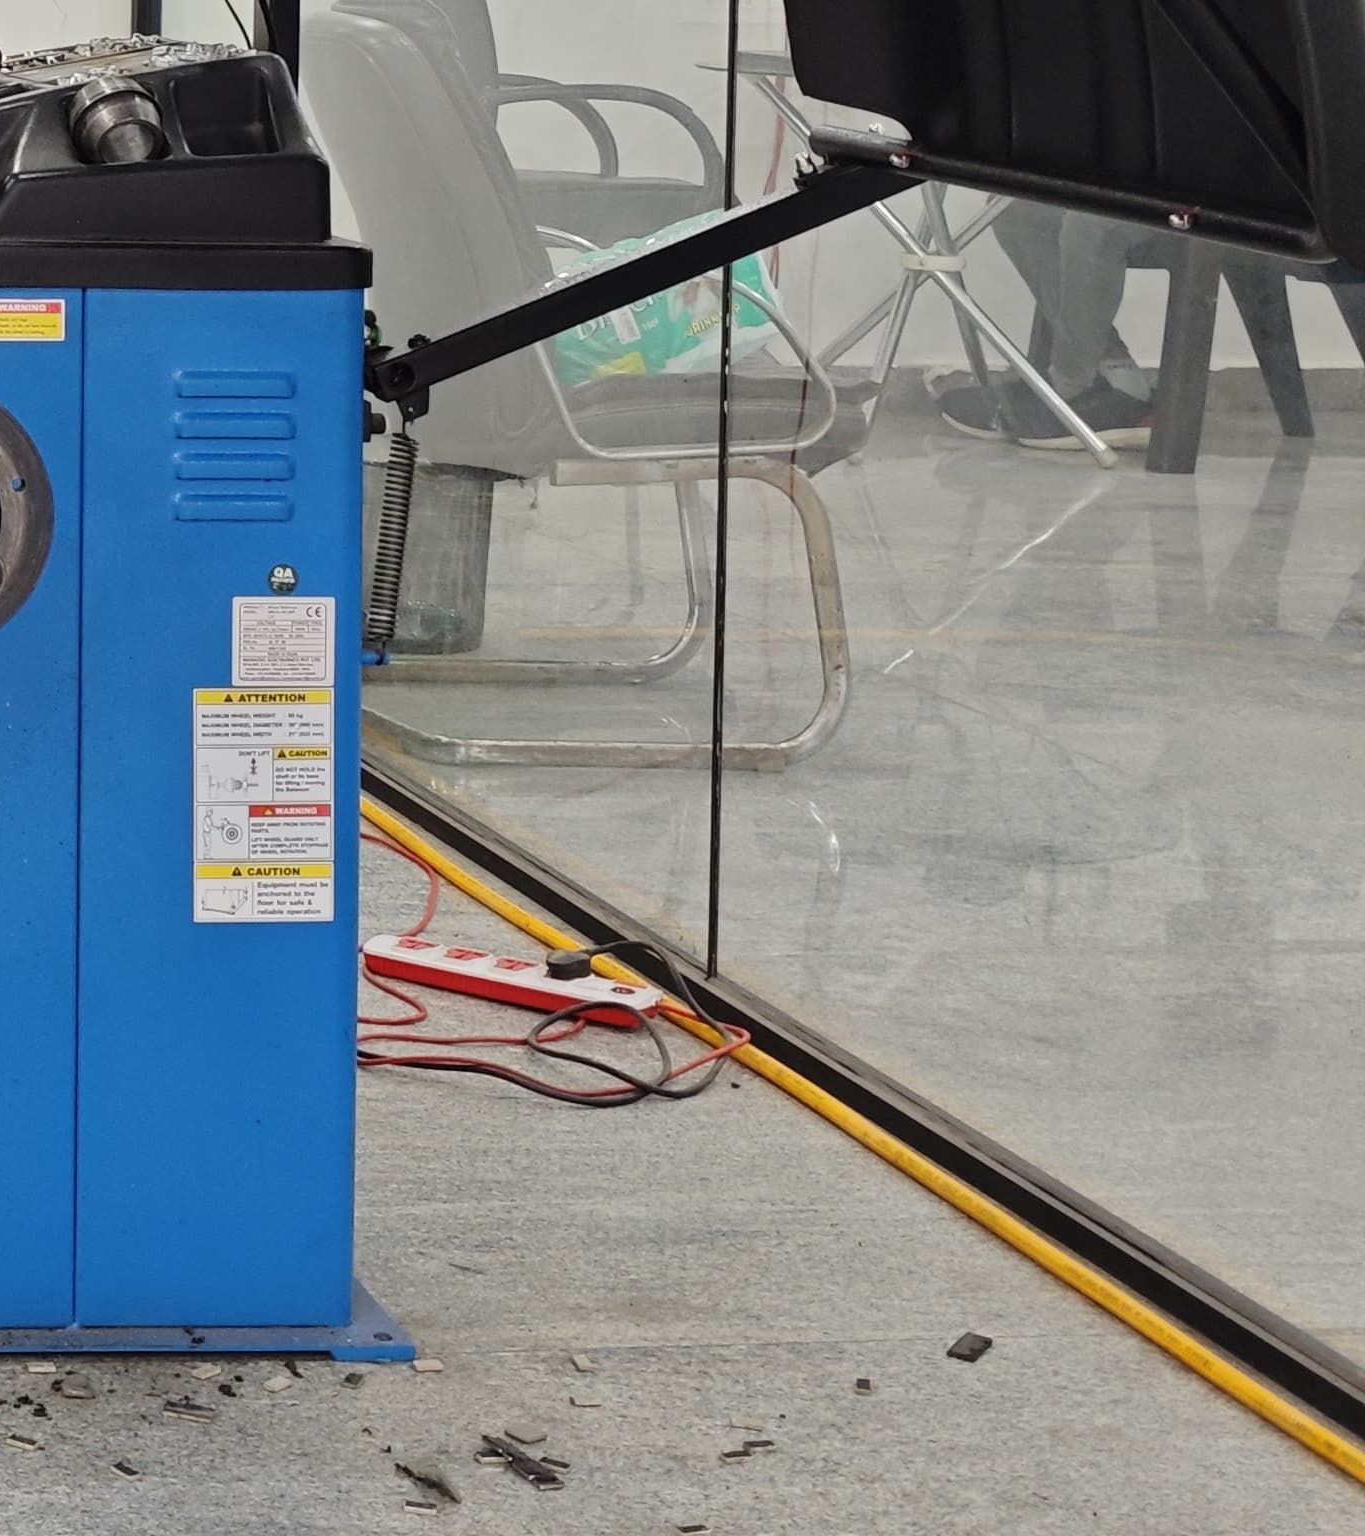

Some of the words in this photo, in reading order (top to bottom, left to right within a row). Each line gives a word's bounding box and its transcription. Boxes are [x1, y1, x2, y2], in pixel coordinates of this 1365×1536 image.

[273, 567, 293, 577] QA
[238, 693, 306, 703] ATTENTION
[247, 867, 300, 876] CAUTION
